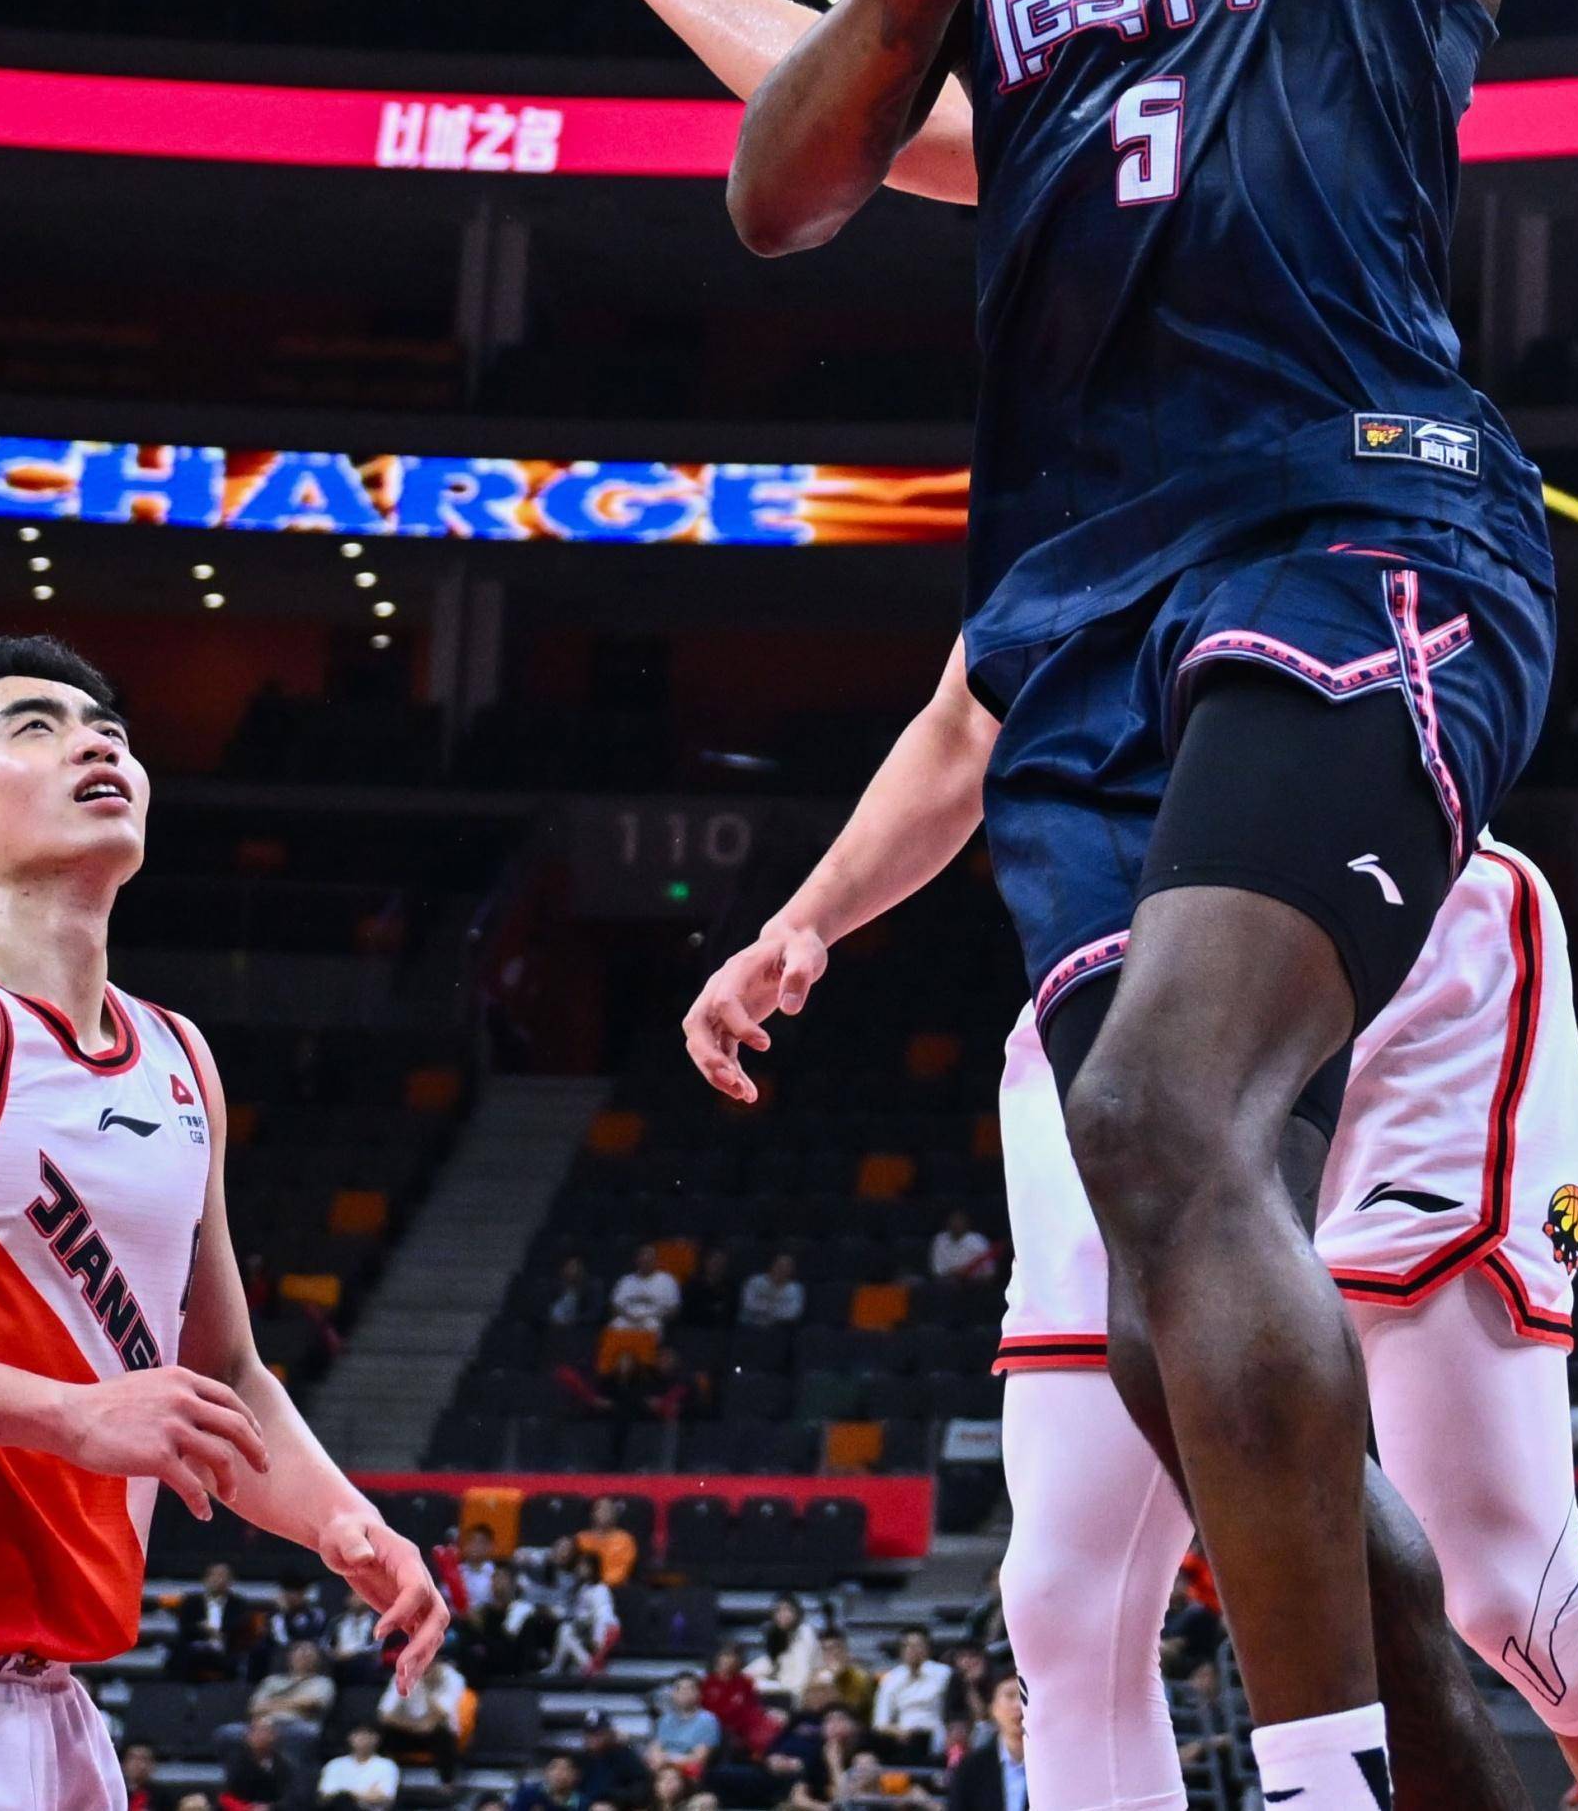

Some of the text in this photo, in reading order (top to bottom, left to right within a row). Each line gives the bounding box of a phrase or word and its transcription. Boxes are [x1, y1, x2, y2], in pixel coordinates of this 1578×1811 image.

[1111, 75, 1185, 207] 5
[618, 812, 753, 867] 110
[24, 1148, 163, 1373] JIANG
